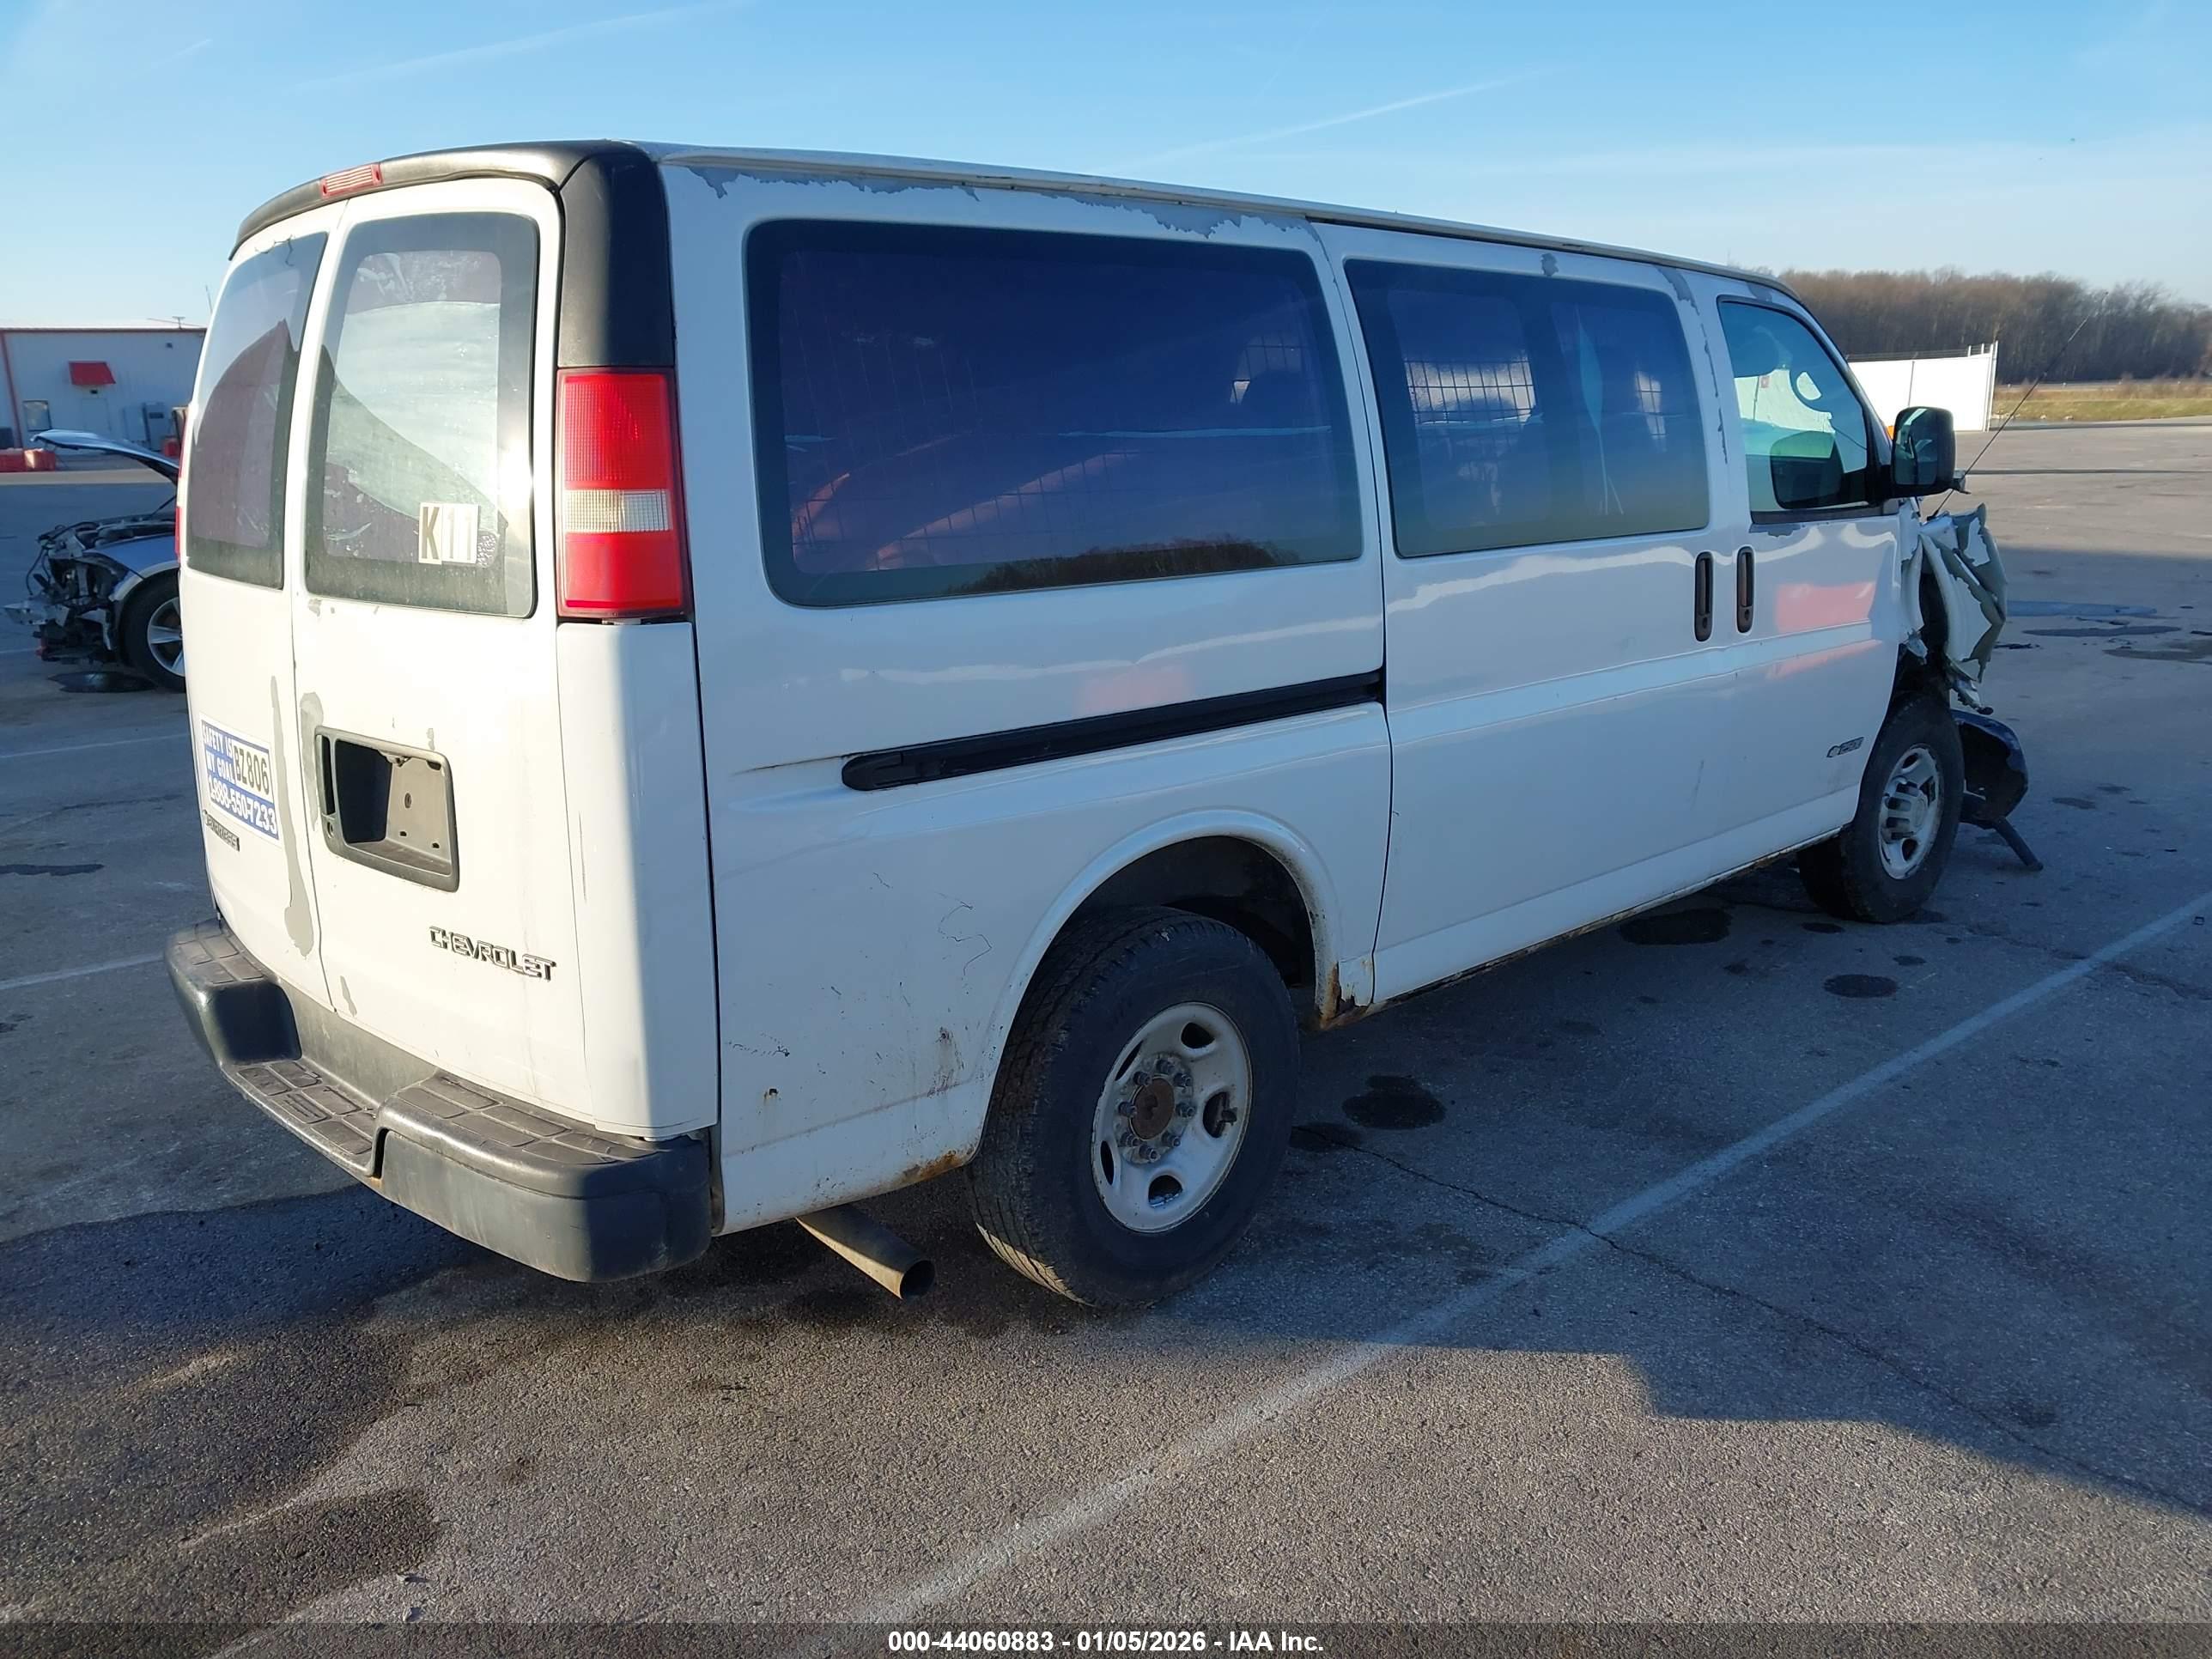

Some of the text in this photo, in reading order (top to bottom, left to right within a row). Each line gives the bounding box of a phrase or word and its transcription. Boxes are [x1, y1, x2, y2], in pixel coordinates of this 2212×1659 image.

[202, 725, 233, 758] SAFETY IS
[217, 758, 234, 783] GOAL
[234, 745, 270, 795] BZ806
[429, 926, 556, 981] CHEVROLET
